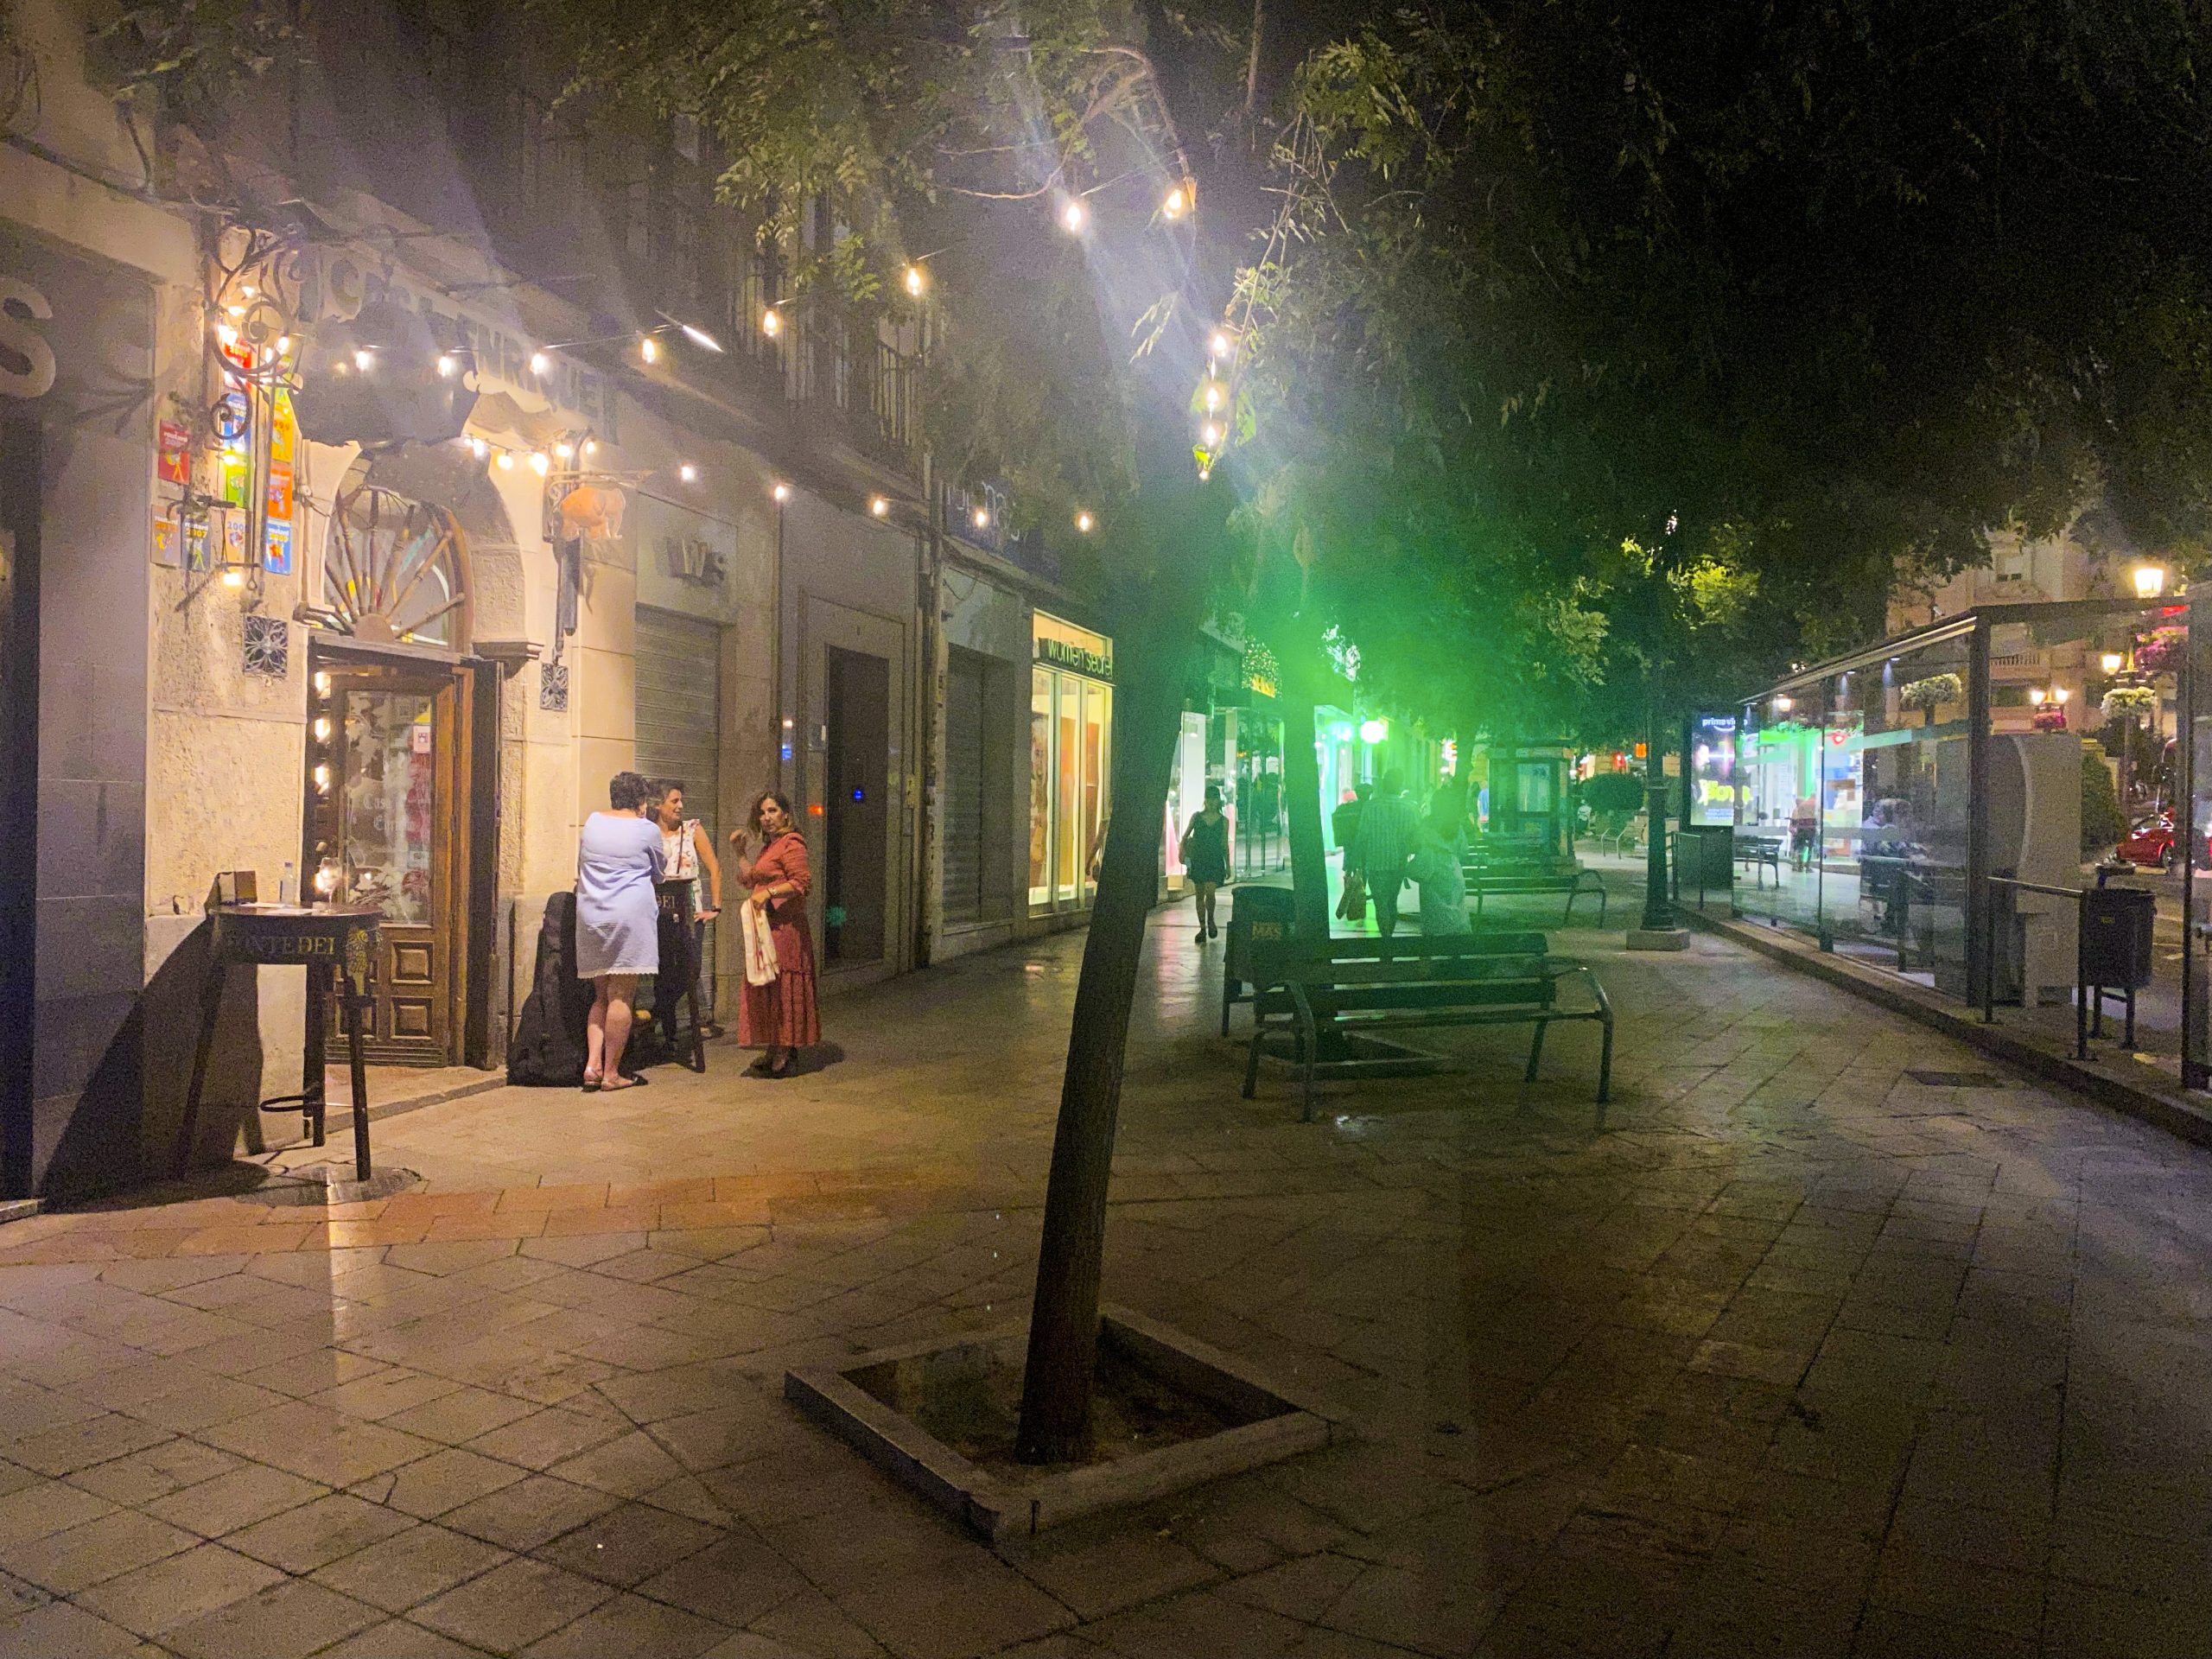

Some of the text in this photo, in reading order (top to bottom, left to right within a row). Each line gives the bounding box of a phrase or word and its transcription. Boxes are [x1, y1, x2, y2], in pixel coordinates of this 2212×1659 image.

[0, 276, 56, 398] S
[227, 521, 245, 531] 200
[1701, 717, 1726, 727] prime
